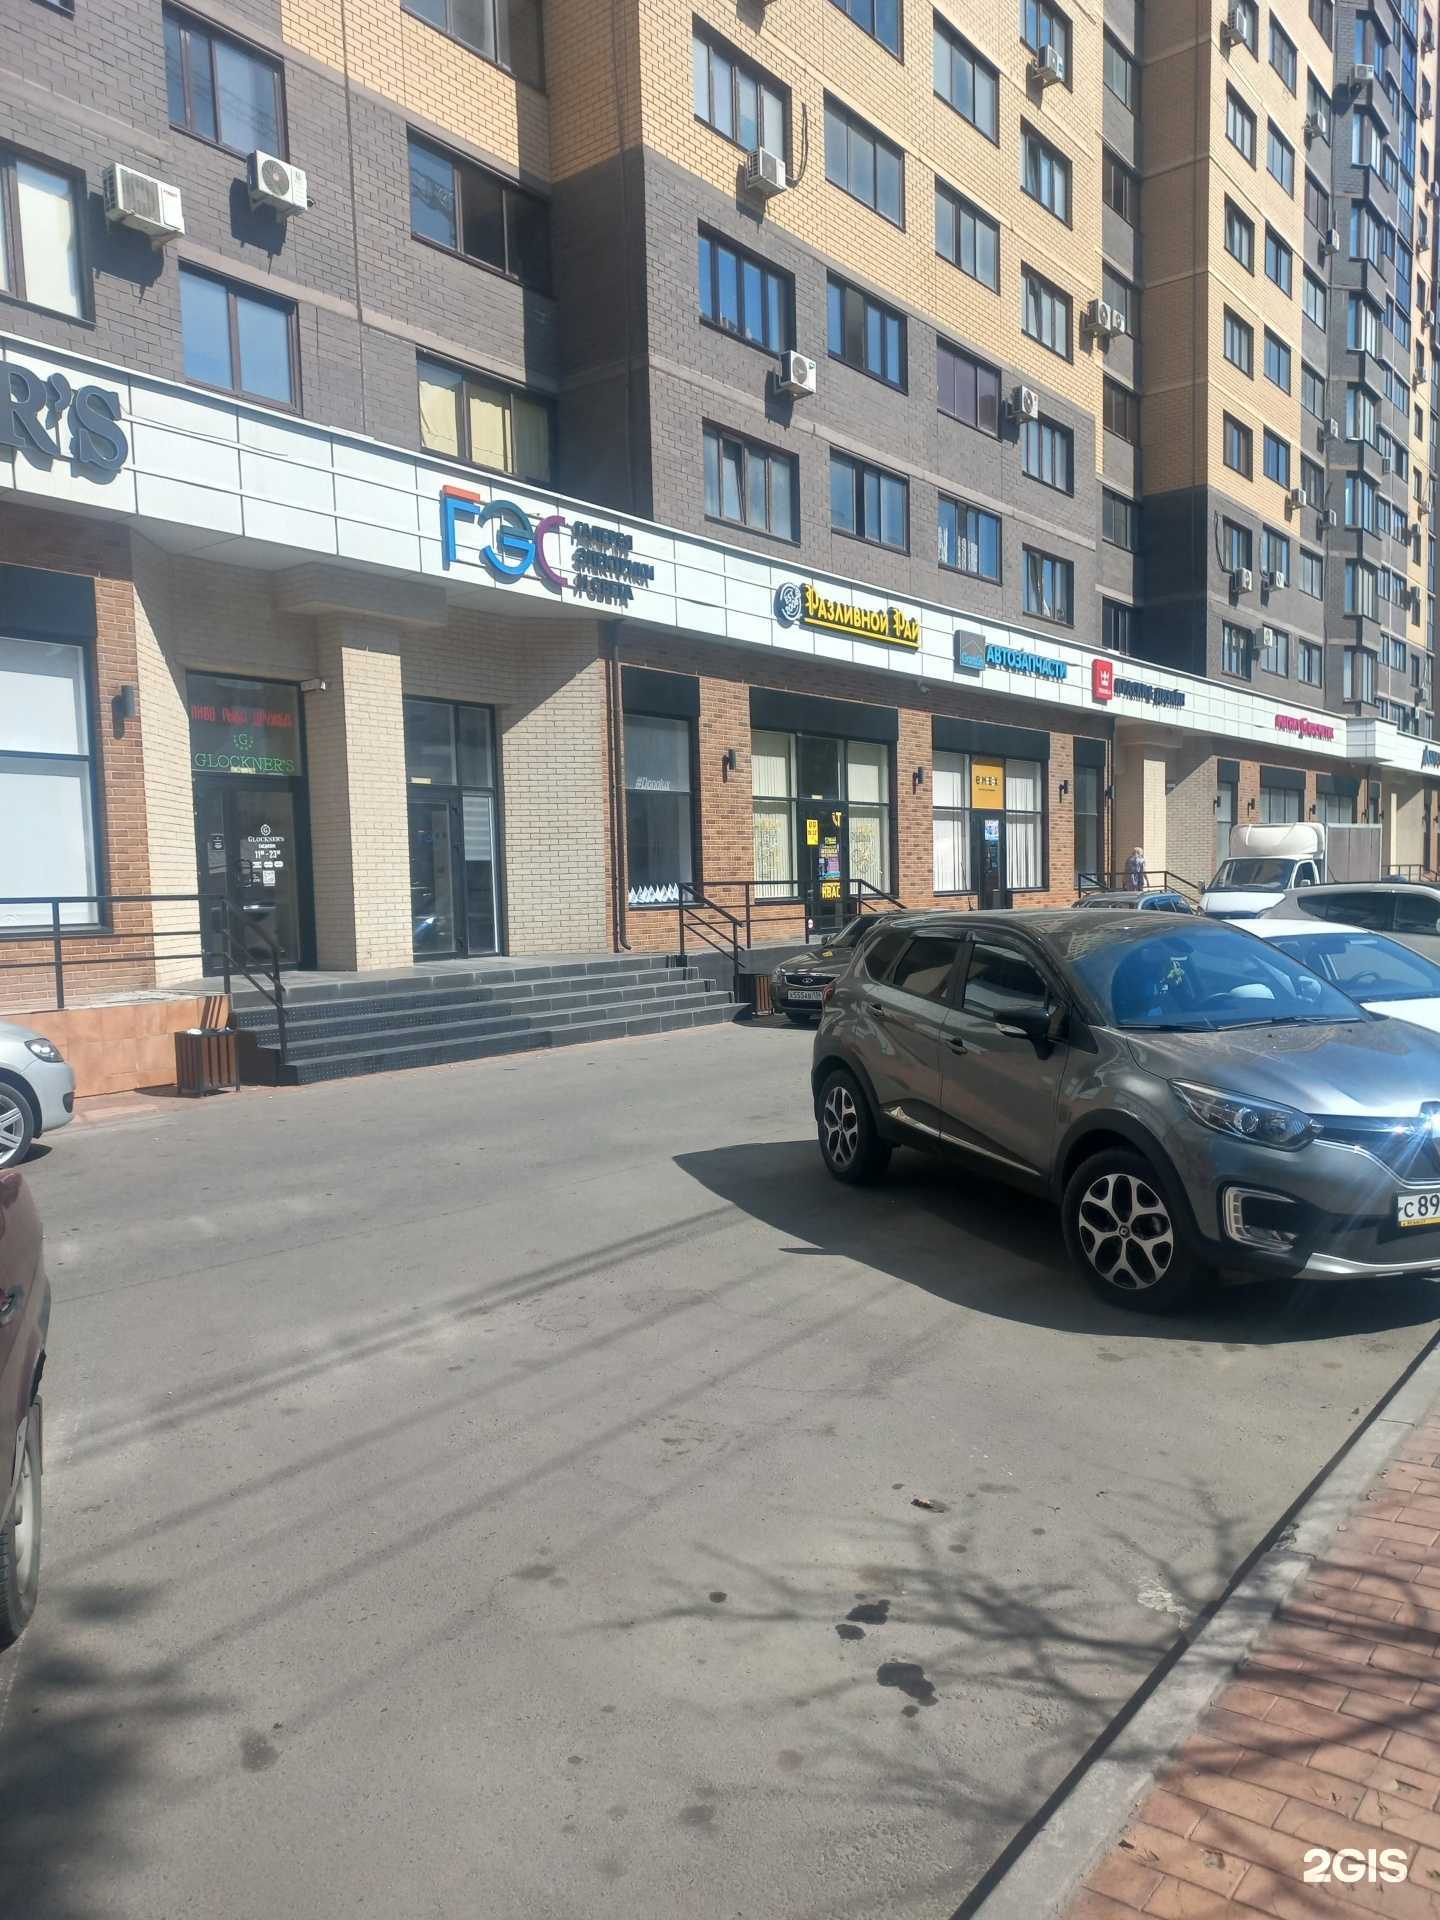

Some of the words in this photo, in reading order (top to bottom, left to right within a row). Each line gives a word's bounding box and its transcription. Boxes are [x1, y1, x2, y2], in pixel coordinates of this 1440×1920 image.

[441, 484, 568, 588] ГЭС
[805, 584, 888, 636] РАЗЛИВНОЙ
[893, 608, 920, 640] РАЙ
[986, 645, 1067, 679] АВТОЗАПЧАСТИ
[194, 753, 296, 772] GLOCKNER'S
